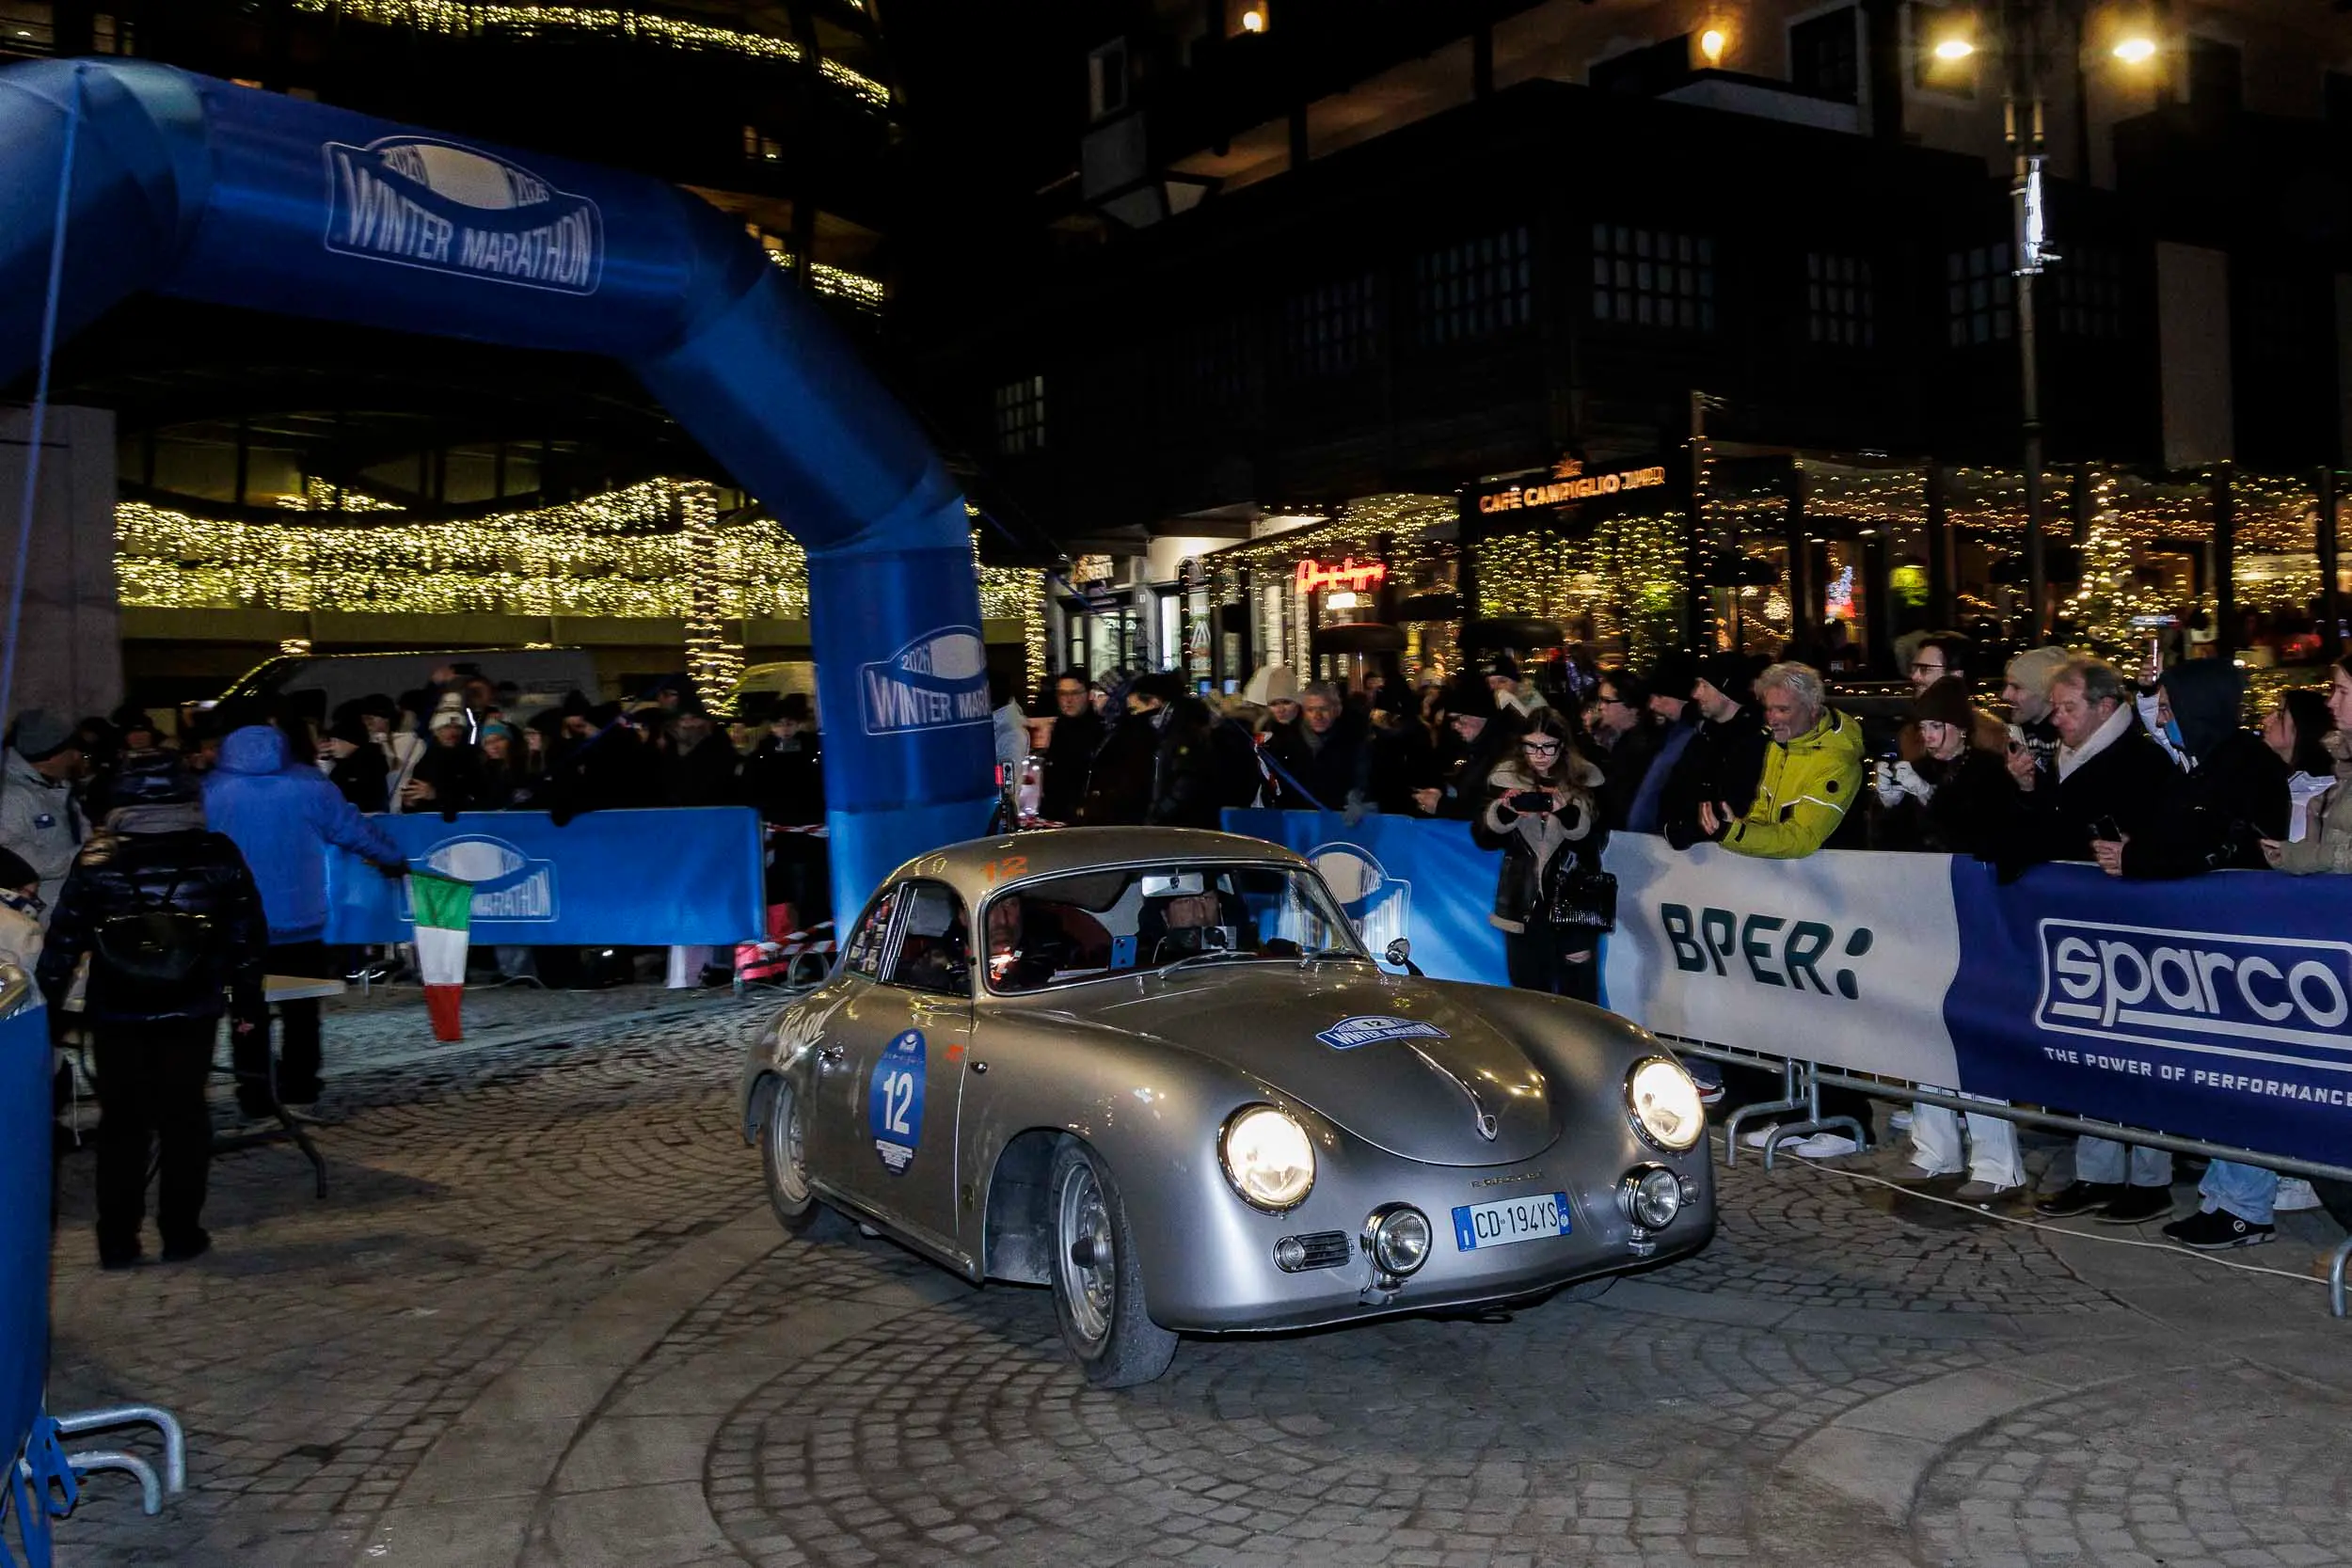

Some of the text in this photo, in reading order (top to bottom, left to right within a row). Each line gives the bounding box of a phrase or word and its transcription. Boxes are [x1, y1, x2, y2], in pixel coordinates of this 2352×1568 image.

[338, 151, 593, 286] WINTER MARATHON
[1523, 474, 1620, 507] CAMPIGLIO
[866, 670, 952, 727] WINTER
[980, 857, 1028, 882] 12
[2057, 937, 2349, 1027] sparco
[1327, 1031, 1386, 1045] WINTER
[882, 1070, 914, 1134] 12
[2043, 1047, 2352, 1107] THE POWER OF PERFORMANCE
